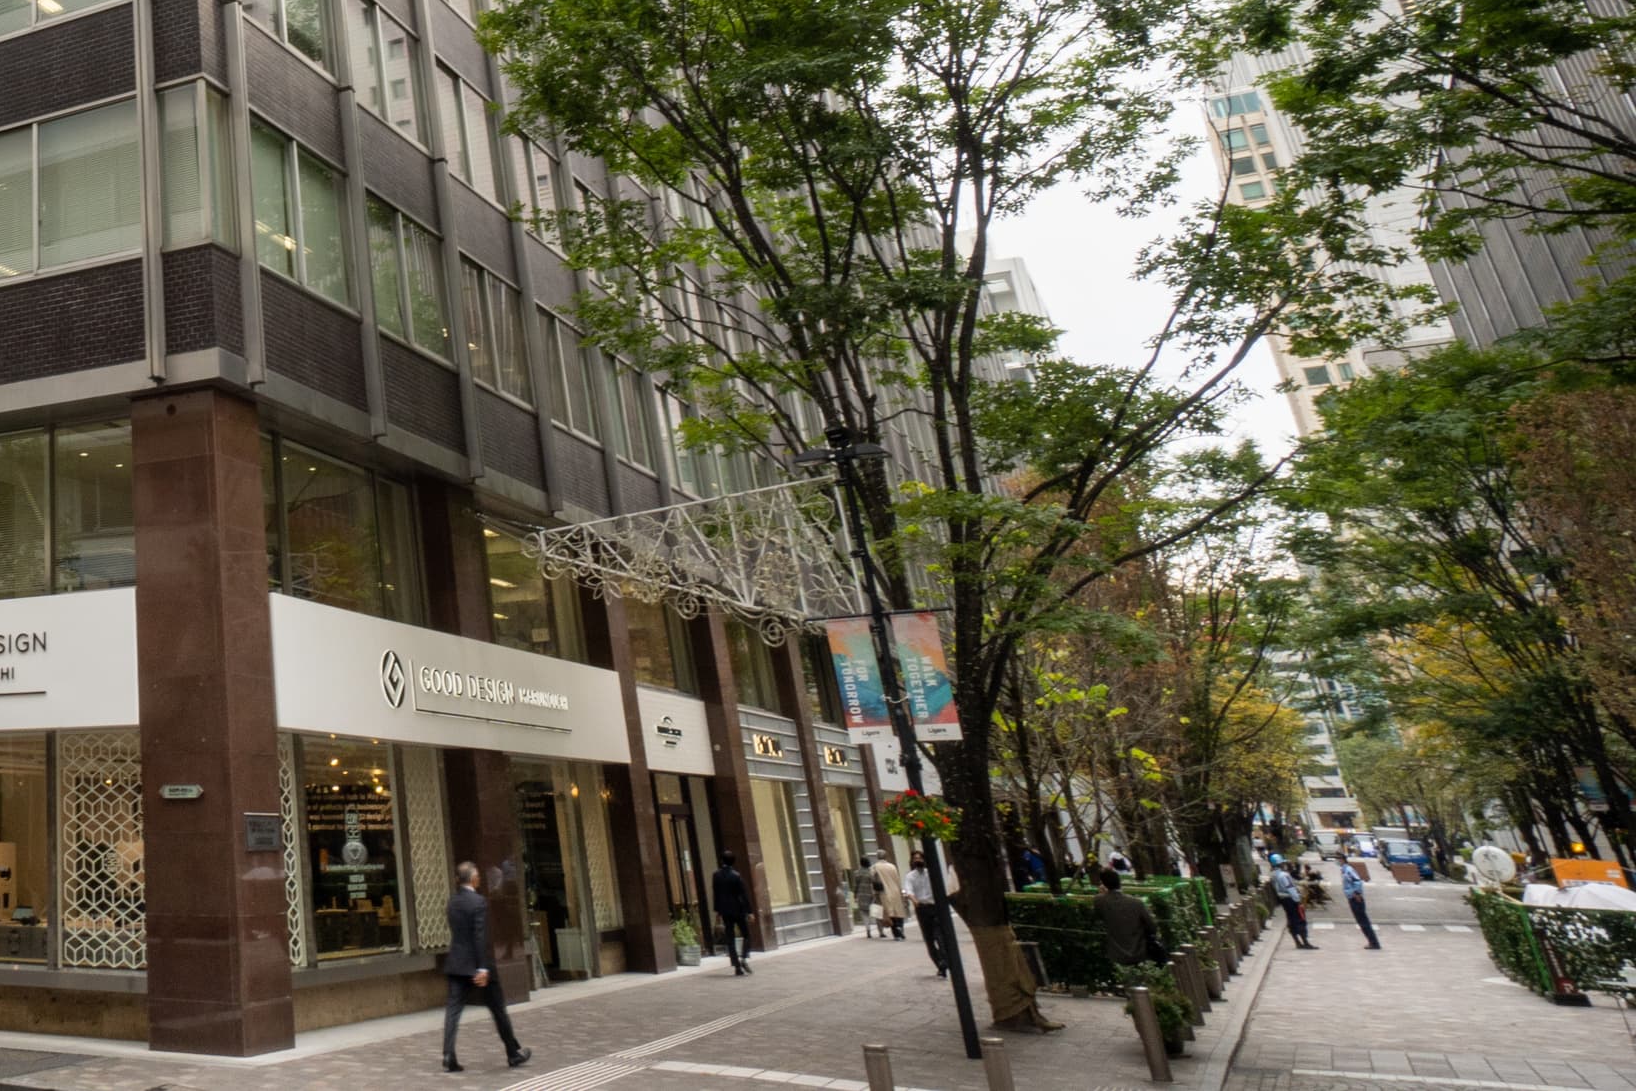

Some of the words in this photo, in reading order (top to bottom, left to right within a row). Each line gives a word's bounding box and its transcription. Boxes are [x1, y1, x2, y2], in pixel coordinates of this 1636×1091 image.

[420, 665, 464, 698] GOOD
[466, 673, 516, 705] DESIGN
[851, 659, 870, 682] FOR
[905, 657, 930, 719] TOGETHER
[921, 655, 939, 687] WALK
[839, 661, 864, 724] TOMORROW
